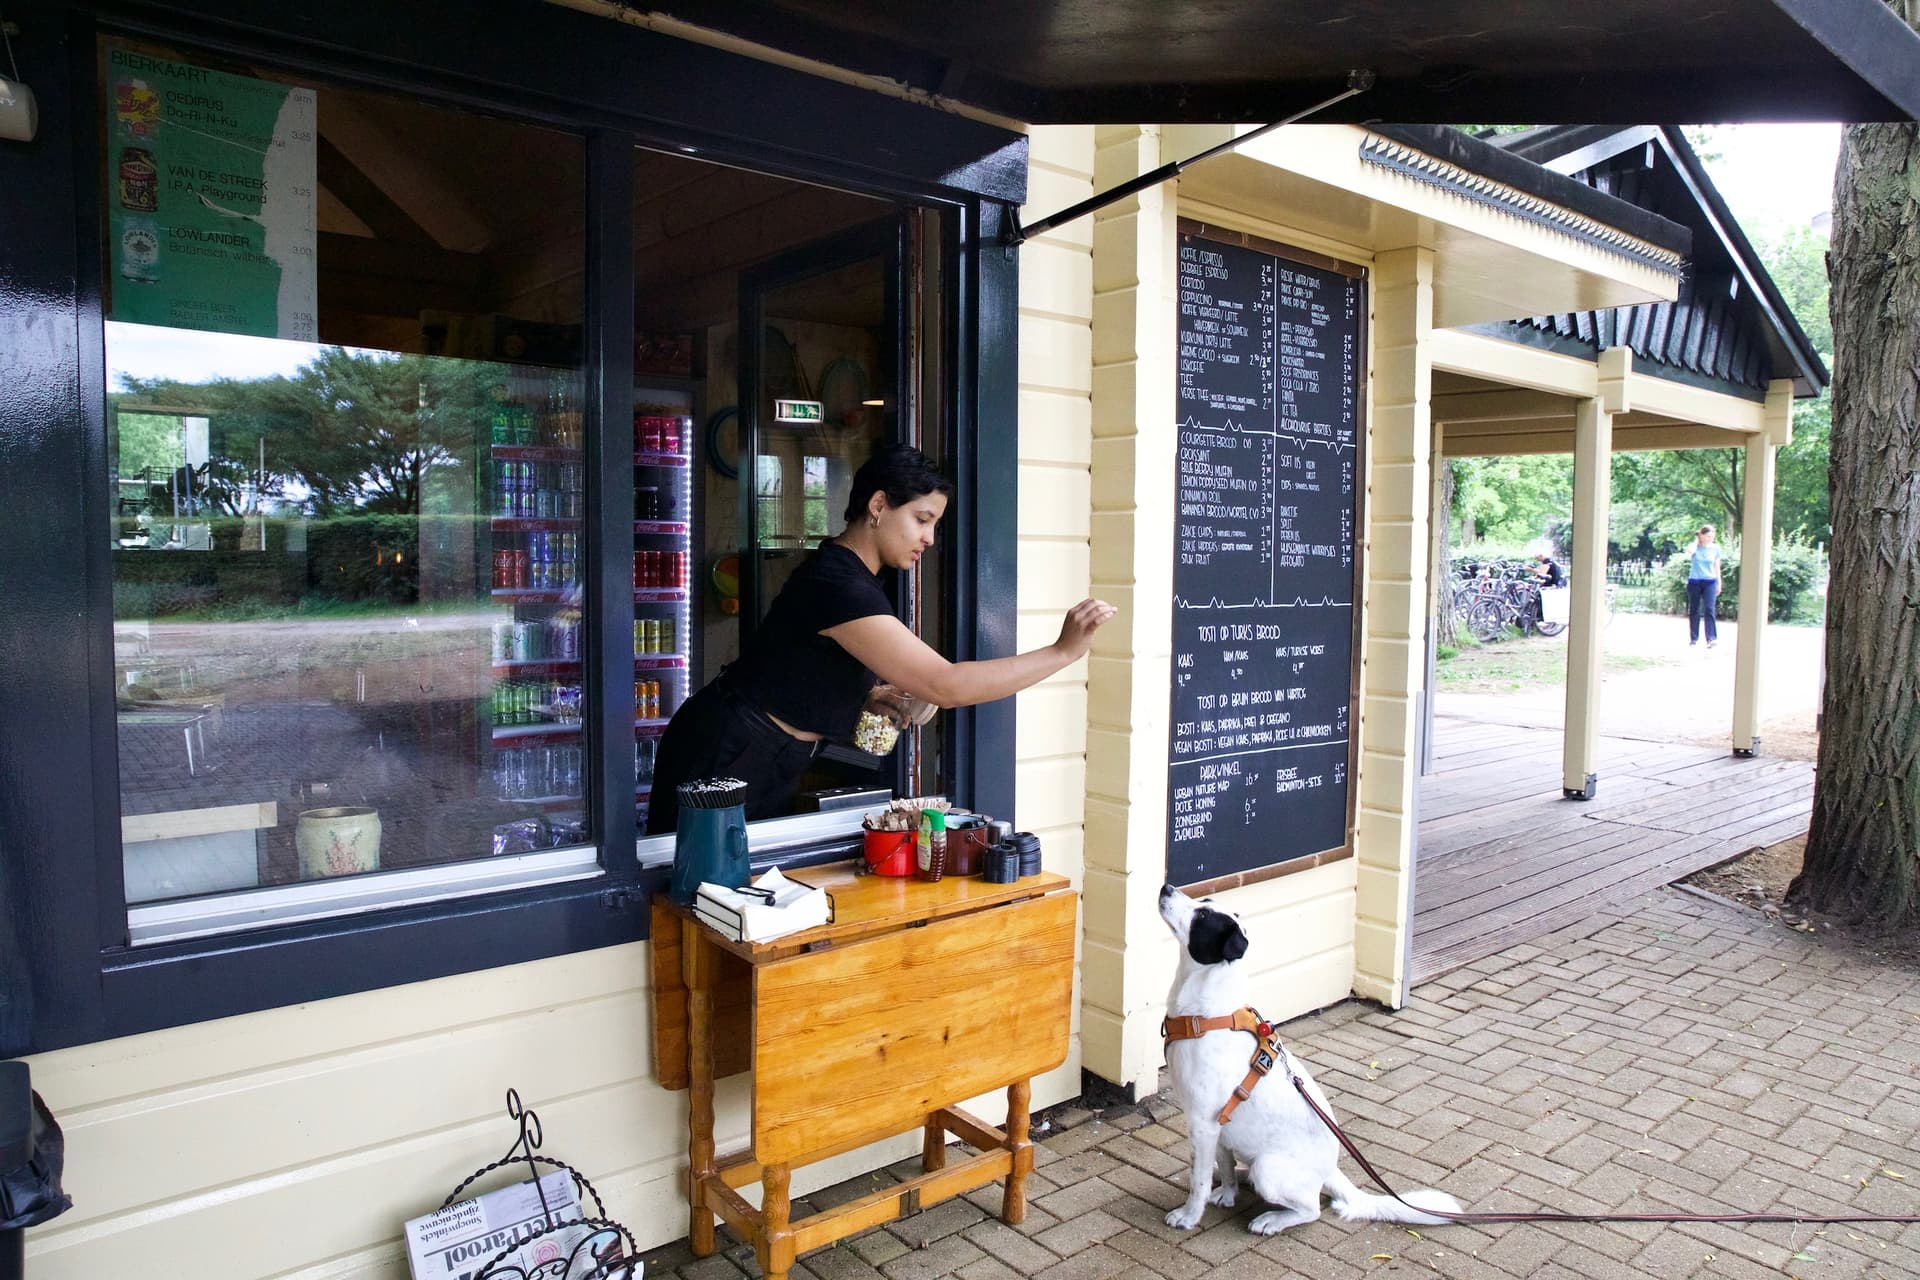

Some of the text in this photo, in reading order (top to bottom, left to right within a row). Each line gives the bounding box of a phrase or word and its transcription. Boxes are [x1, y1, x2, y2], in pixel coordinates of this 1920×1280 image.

[111, 50, 209, 83] BIERKAART
[166, 90, 224, 112] OEDIPUS
[167, 164, 195, 181] VAN
[199, 170, 216, 184] DE
[219, 174, 269, 191] STREEK
[201, 185, 267, 205] Playground
[168, 226, 250, 248] LOWLANDER
[1180, 247, 1197, 262] KOFFIE
[1180, 373, 1194, 385] THEE
[1180, 432, 1215, 447] COURGETTE
[1216, 435, 1237, 449] BROOD
[1180, 447, 1210, 462] CROISSANT
[1281, 454, 1292, 467] SOFT
[1181, 475, 1198, 487] LEMON
[1180, 489, 1222, 503] CINNAMON ROLL
[1181, 503, 1205, 516] BANANEN
[1198, 624, 1281, 643] TOSTI OP TURKS BROOD
[1178, 653, 1194, 668] KAAS
[1310, 644, 1325, 656] WORST
[1197, 694, 1216, 710] TOSTI
[1219, 694, 1228, 708] OP
[1231, 692, 1249, 707] BRUIN
[1251, 690, 1273, 705] BROOD
[1274, 689, 1285, 702] VAN
[1266, 712, 1291, 725] OREGANO
[1174, 740, 1192, 754] VEGAN
[1217, 735, 1235, 749] VEGAN
[1275, 728, 1288, 742] RODE
[1276, 766, 1298, 781] FRISBEE
[1174, 780, 1230, 800] URBAN NATURE MAP
[1175, 796, 1216, 814] POTJE HONING
[1175, 811, 1213, 829] ZONNEBRAND
[462, 1205, 481, 1218] zijn
[419, 1214, 454, 1232] nieuwe
[420, 1215, 483, 1242] Snoepwinkels
[444, 1228, 519, 1272] Parool
